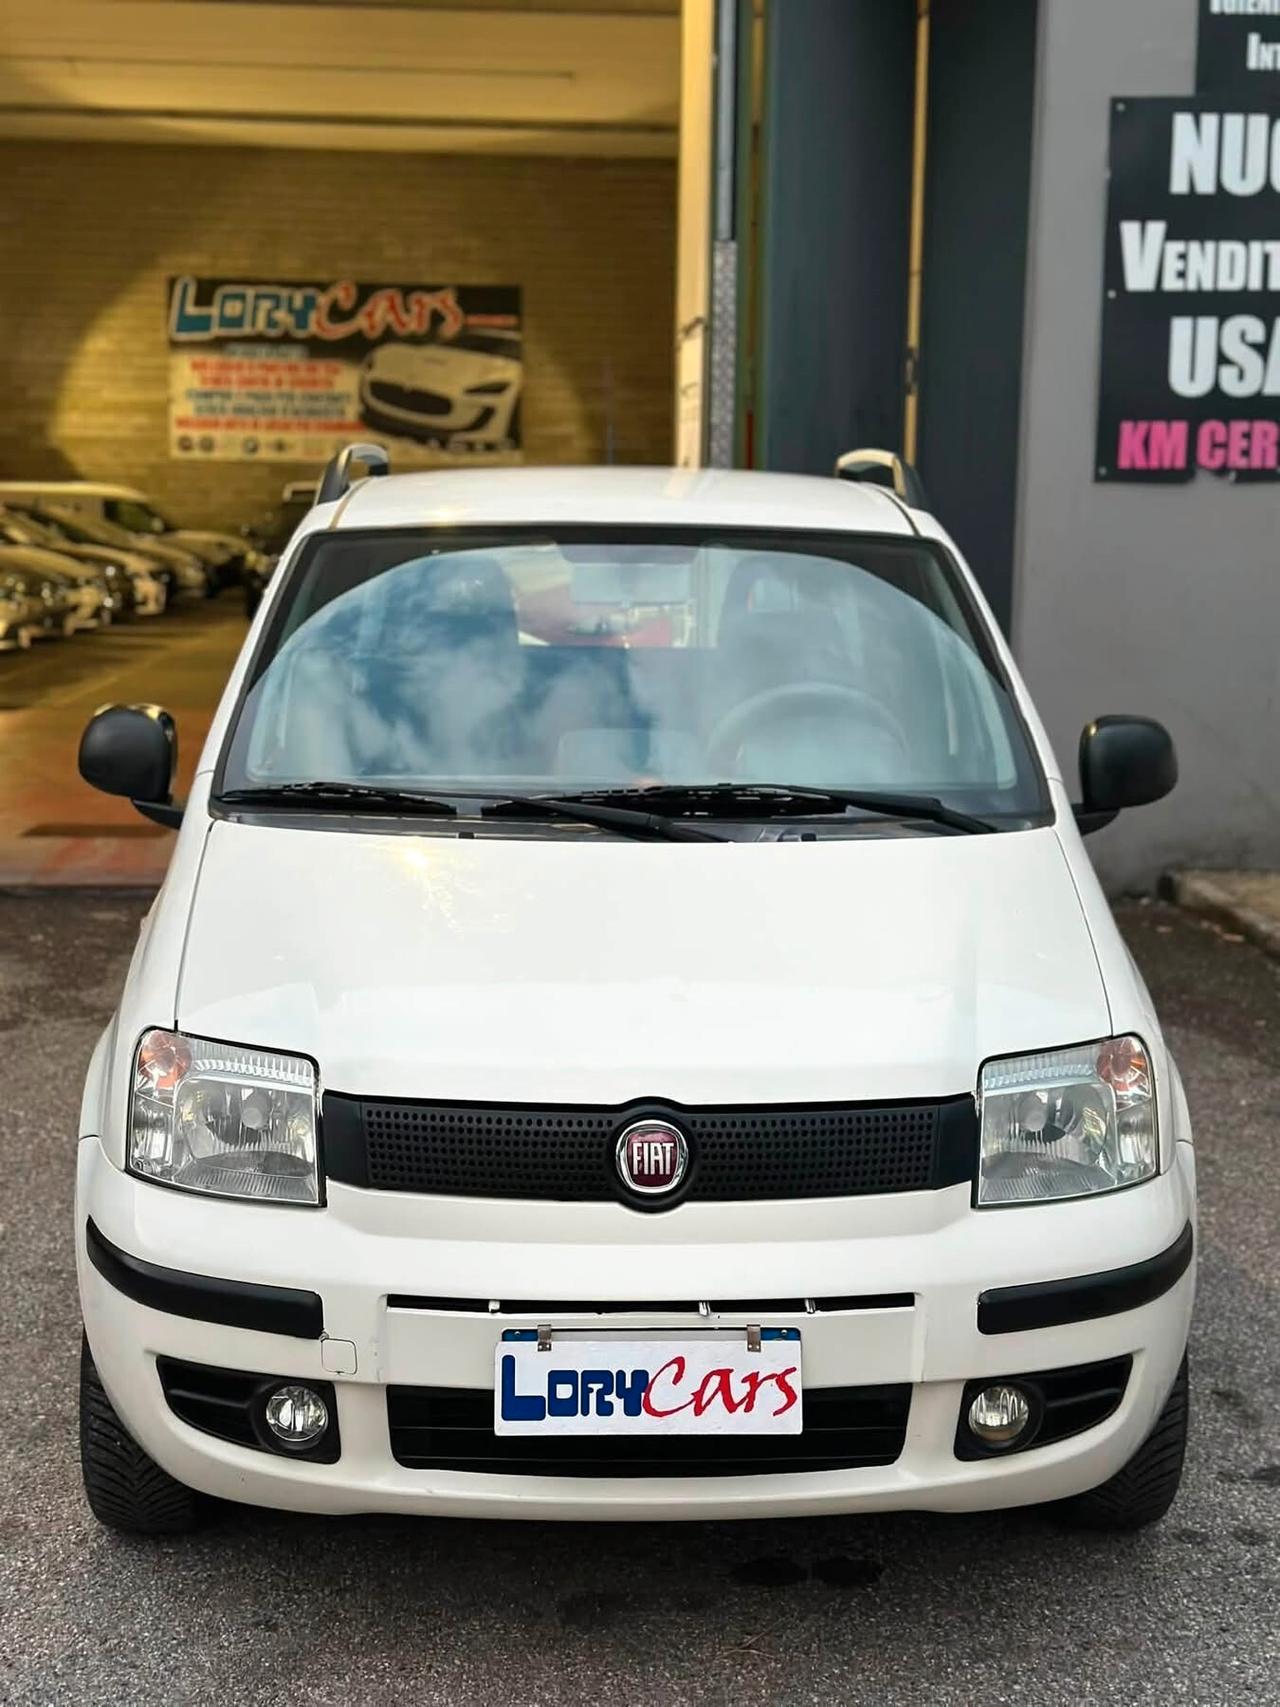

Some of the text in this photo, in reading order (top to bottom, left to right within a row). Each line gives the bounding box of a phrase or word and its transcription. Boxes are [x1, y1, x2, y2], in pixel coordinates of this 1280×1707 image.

[1169, 112, 1280, 196] NU
[1117, 419, 1279, 470] KM CER
[632, 1142, 674, 1175] FIAT
